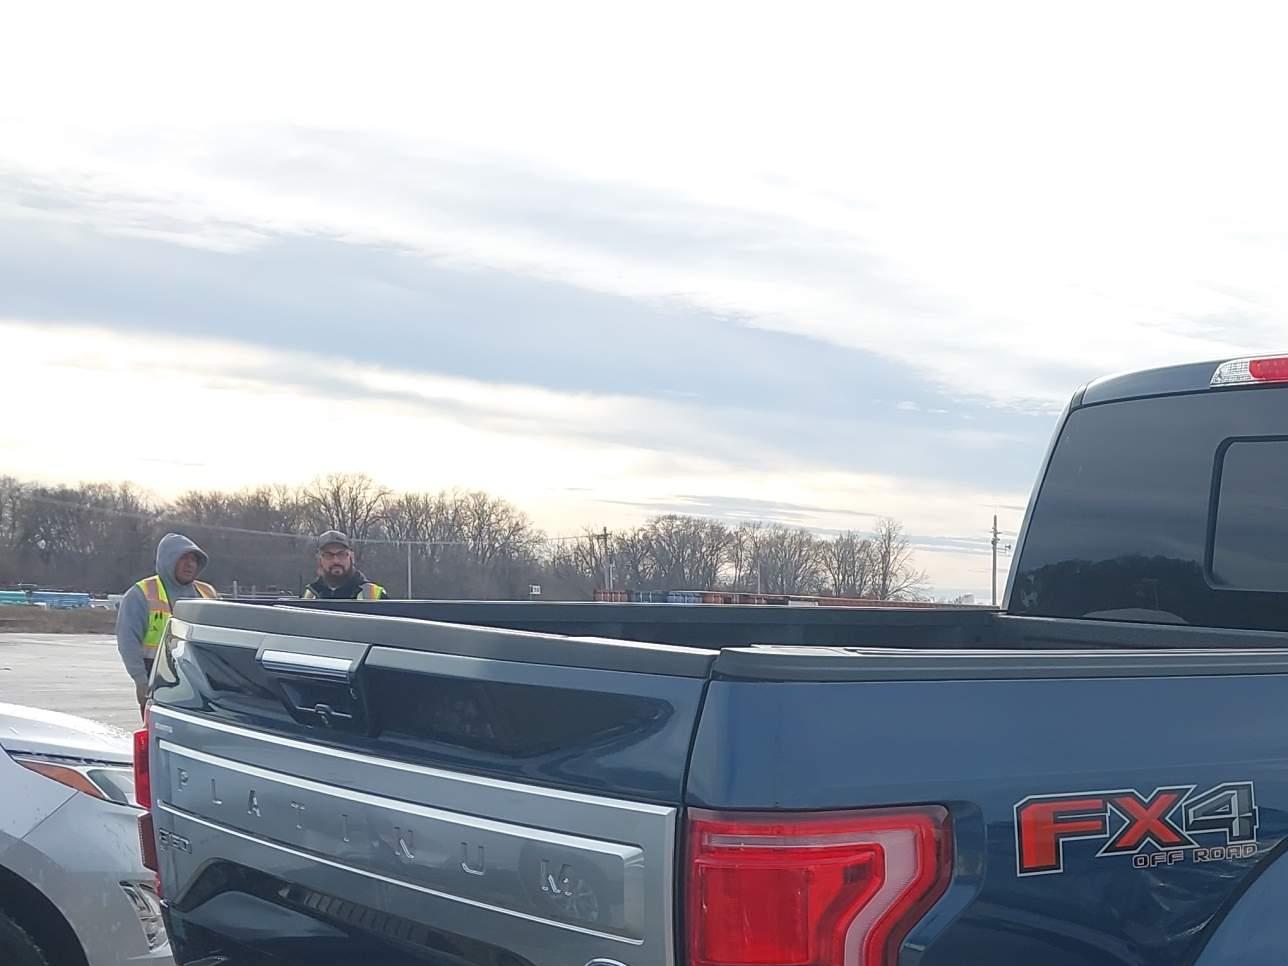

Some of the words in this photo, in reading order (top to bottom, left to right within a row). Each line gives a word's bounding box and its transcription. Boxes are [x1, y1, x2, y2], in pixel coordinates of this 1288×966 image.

[177, 767, 575, 896] PLATINUM
[1013, 781, 1259, 877] FX4
[1132, 850, 1185, 869] OFF
[1193, 843, 1258, 863] ROAD
